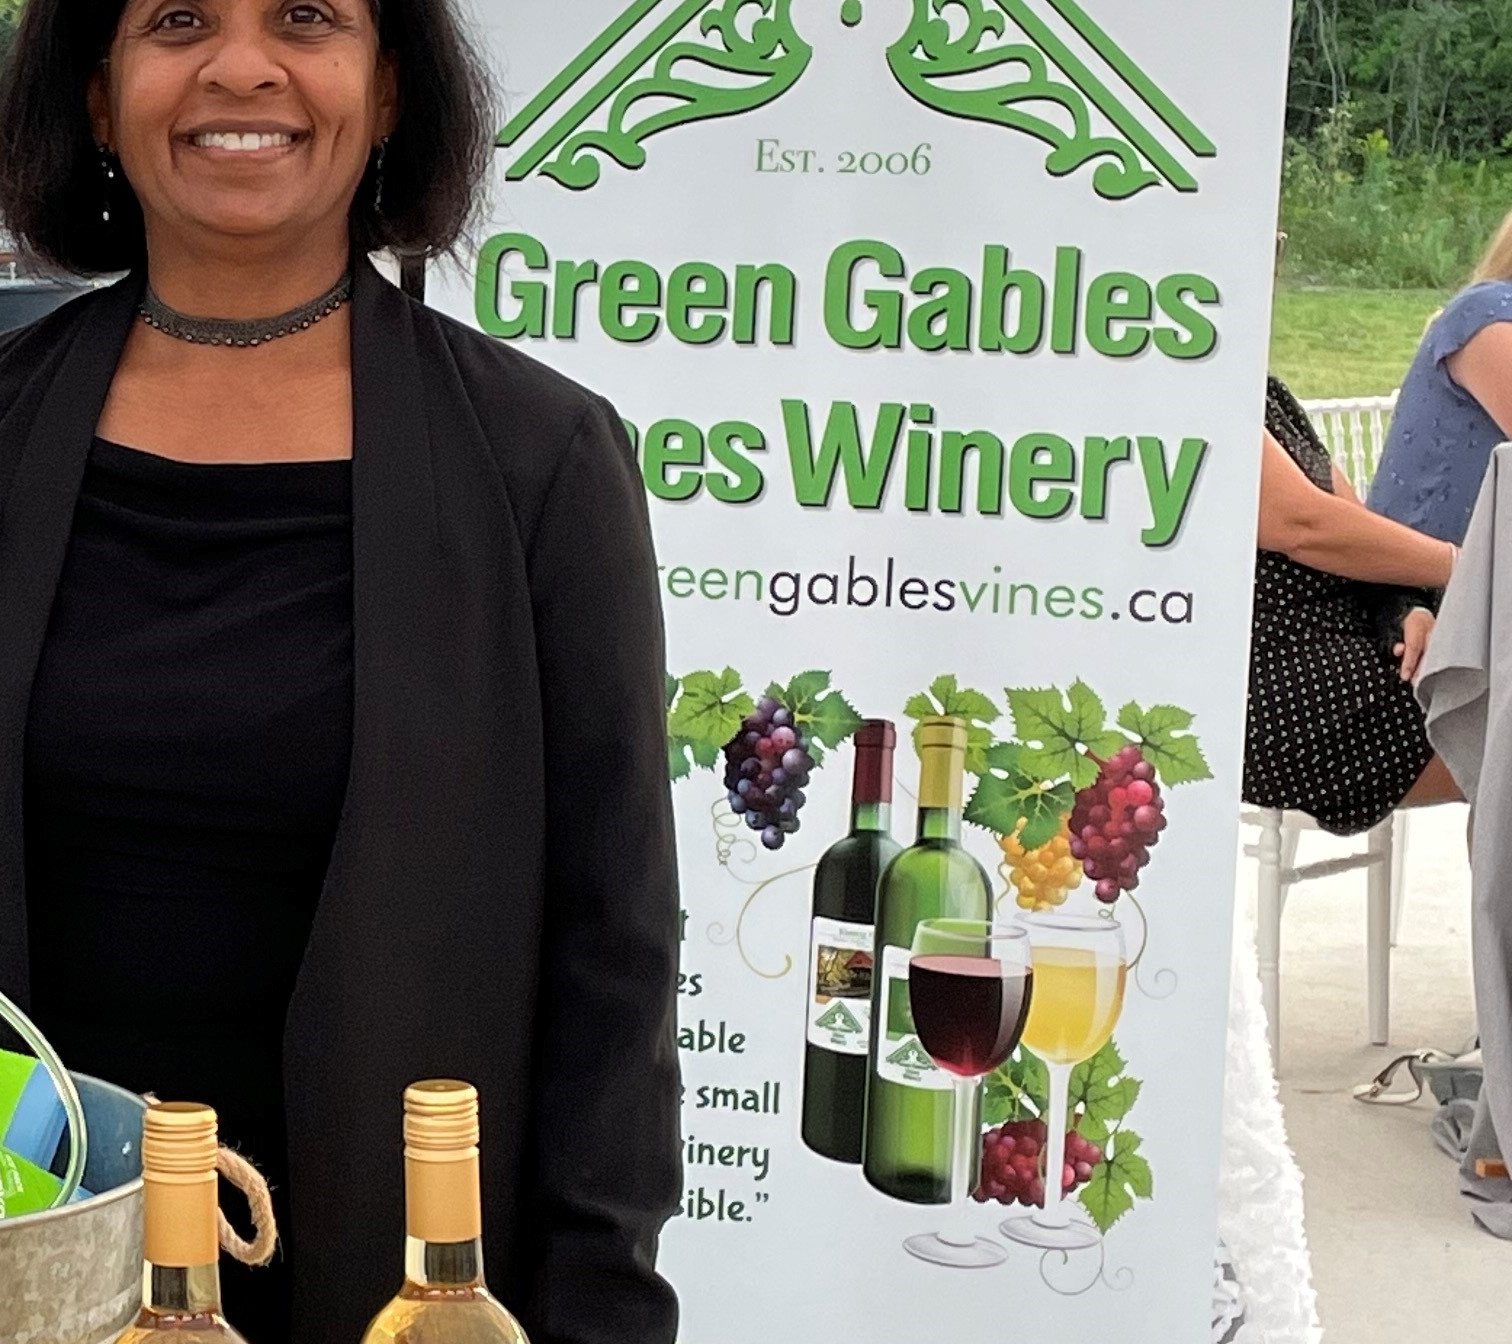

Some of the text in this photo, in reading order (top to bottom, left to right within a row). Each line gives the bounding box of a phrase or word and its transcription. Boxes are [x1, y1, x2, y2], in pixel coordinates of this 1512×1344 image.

[836, 142, 932, 176] 2006
[472, 232, 1224, 361] Green Gables
[622, 398, 1210, 550] es Winery
[659, 555, 1196, 626] eengablesvines.ca
[678, 972, 703, 996] es
[677, 1019, 746, 1054] able
[695, 1080, 781, 1115] small
[682, 1134, 769, 1182] inery
